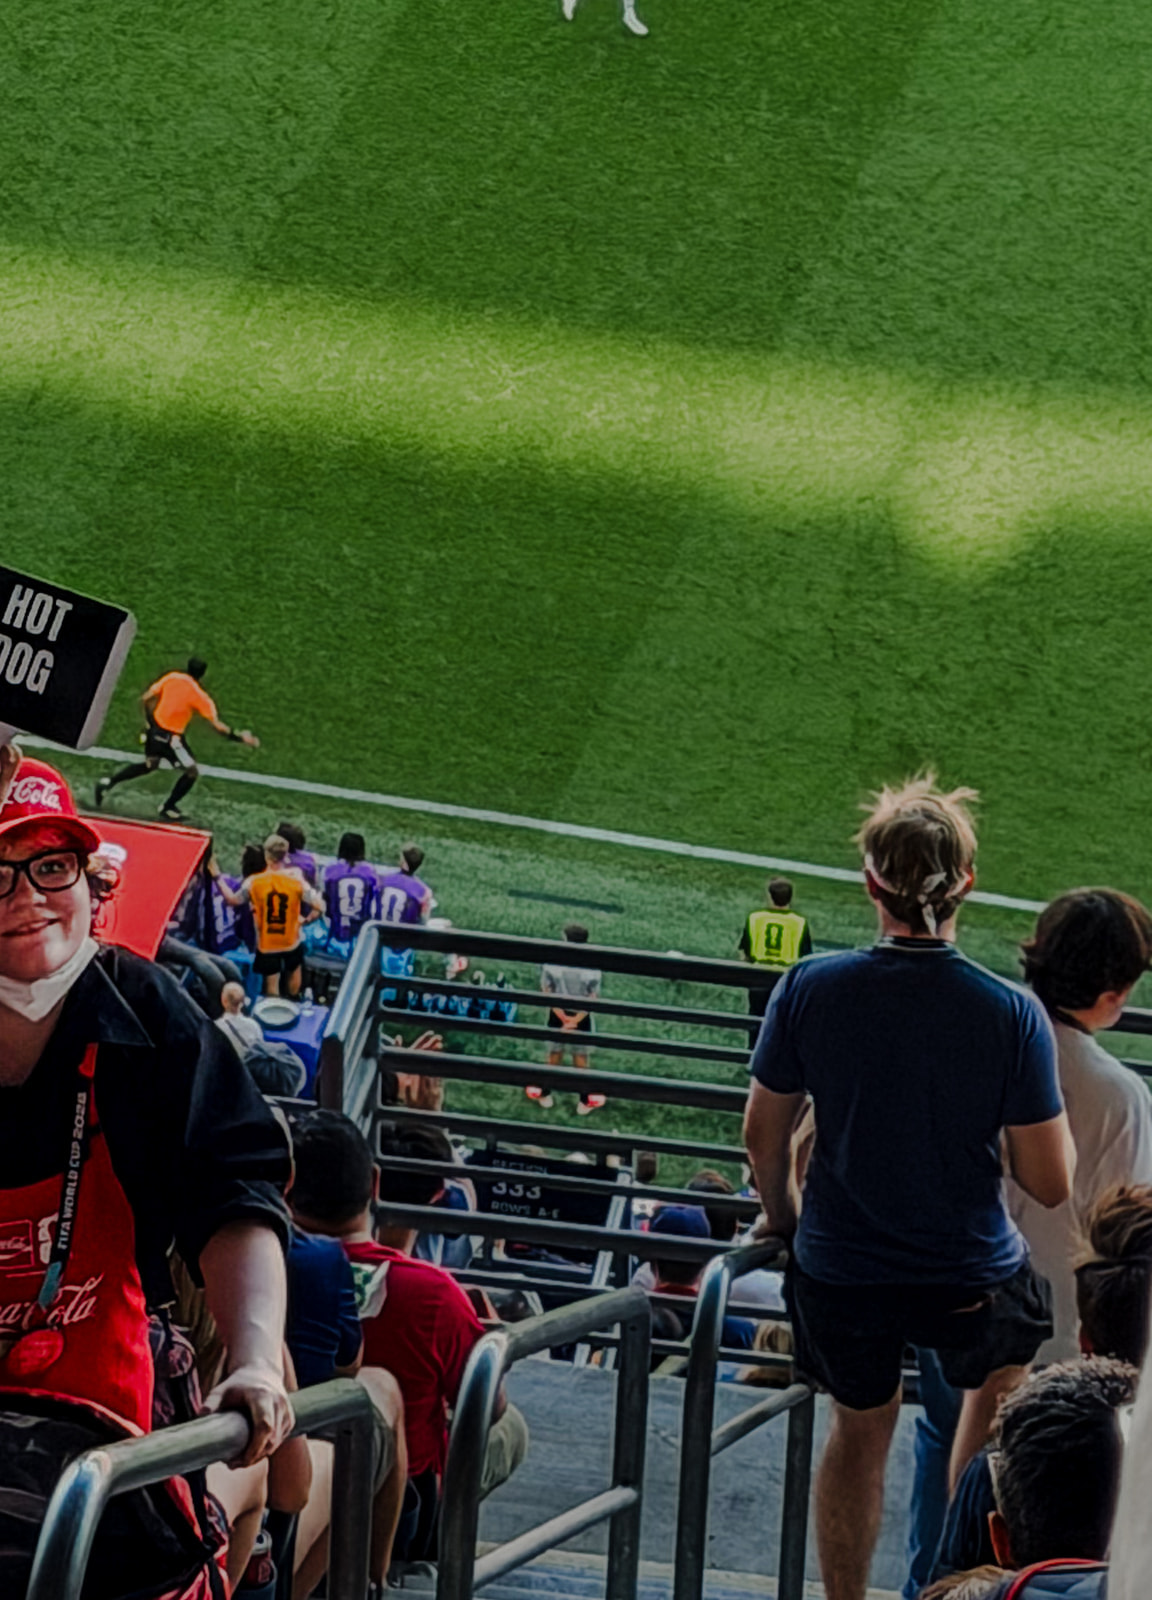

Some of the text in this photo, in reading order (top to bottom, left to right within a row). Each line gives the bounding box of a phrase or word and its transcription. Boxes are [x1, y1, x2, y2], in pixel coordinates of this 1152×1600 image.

[1, 583, 74, 642] HOT
[69, 1141, 81, 1168] CUP
[62, 1169, 79, 1219] WORLD
